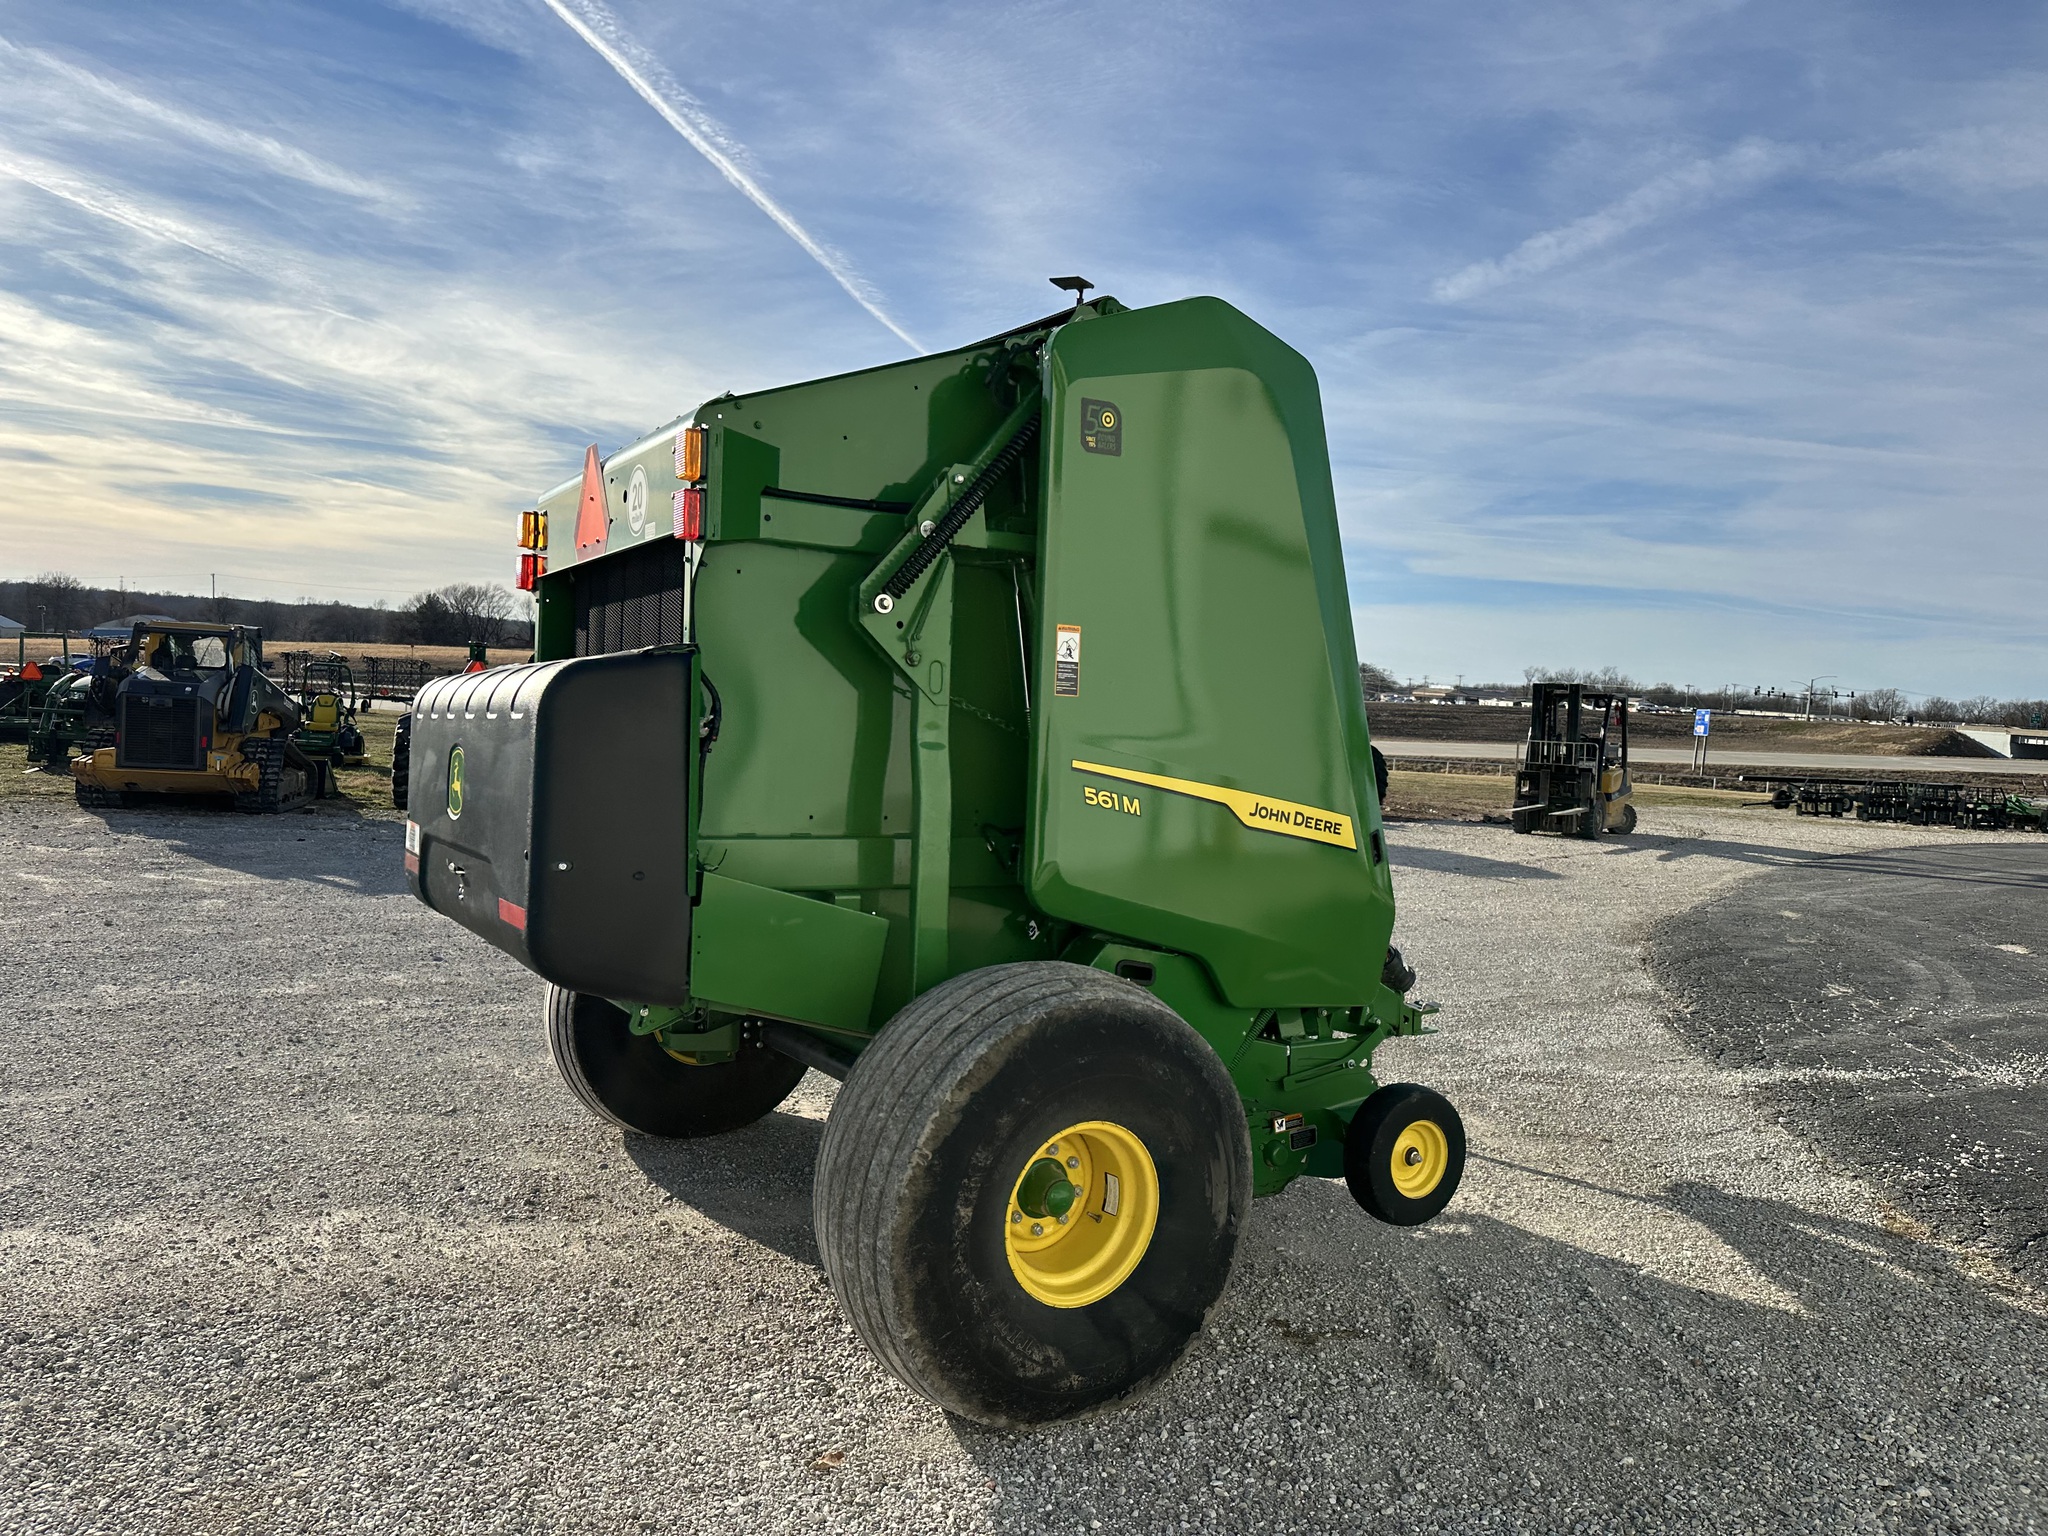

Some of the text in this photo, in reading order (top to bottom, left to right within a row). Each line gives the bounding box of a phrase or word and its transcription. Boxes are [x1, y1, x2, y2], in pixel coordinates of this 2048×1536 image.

[1084, 405, 1118, 434] 50
[632, 481, 643, 512] 20
[1083, 786, 1142, 817] 561 M
[1249, 802, 1343, 836] JOHN DEERE
